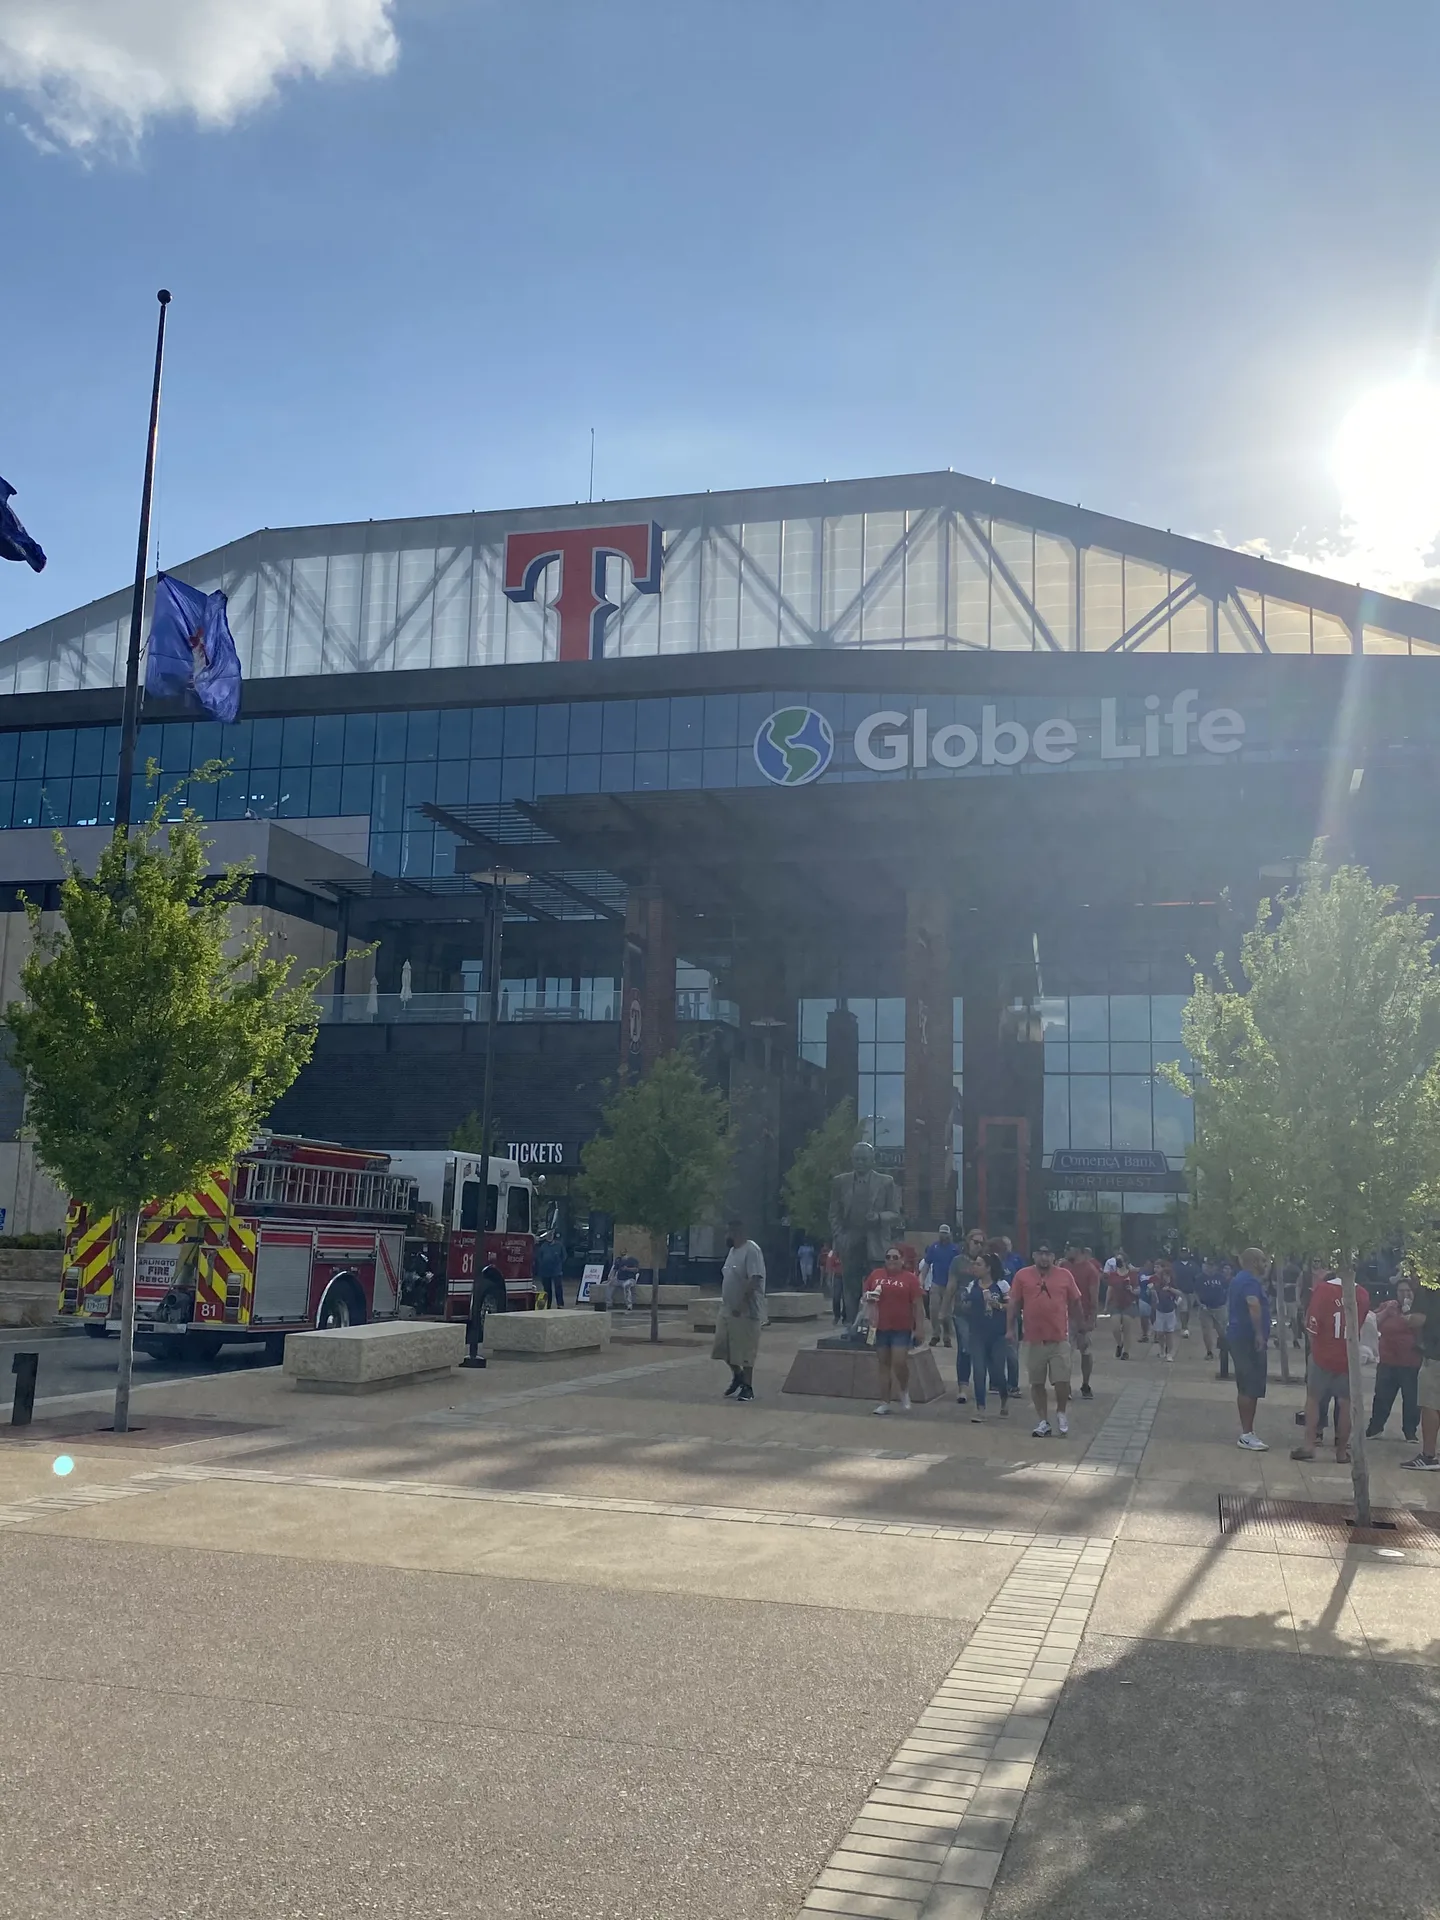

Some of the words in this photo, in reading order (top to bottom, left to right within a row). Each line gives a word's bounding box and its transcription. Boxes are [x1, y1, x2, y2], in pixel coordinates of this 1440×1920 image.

[503, 521, 662, 661] T
[854, 704, 1078, 771] Globe
[1100, 689, 1245, 759] Life
[507, 1142, 563, 1164] TICKETS
[1124, 1155, 1157, 1167] Bank
[1064, 1176, 1152, 1187] NORTHEAST
[138, 1259, 177, 1267] ARLINGTO
[461, 1253, 474, 1273] 81
[147, 1266, 170, 1276] FIRE
[875, 1278, 904, 1288] TEXAS
[201, 1303, 216, 1317] 81
[1333, 1311, 1346, 1339] 1
